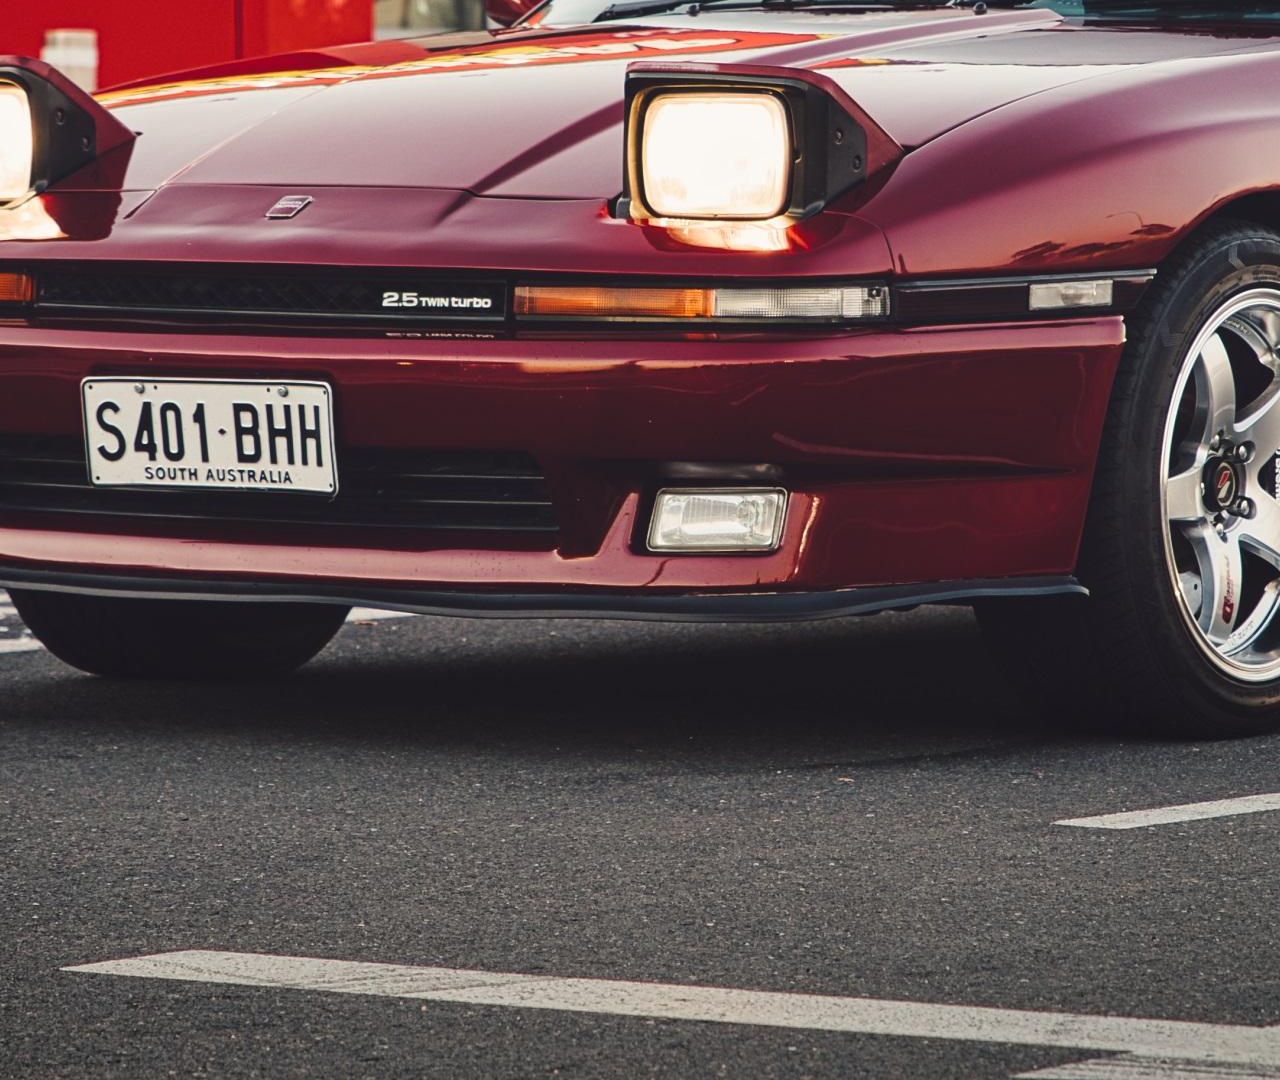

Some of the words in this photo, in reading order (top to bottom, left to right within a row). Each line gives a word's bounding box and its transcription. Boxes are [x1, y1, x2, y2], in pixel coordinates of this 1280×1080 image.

[382, 292, 419, 307] 2.5
[419, 297, 450, 308] TWIN
[451, 297, 492, 309] turbo
[145, 467, 198, 481] SOUTH
[207, 469, 293, 484] AUSTRALIA
